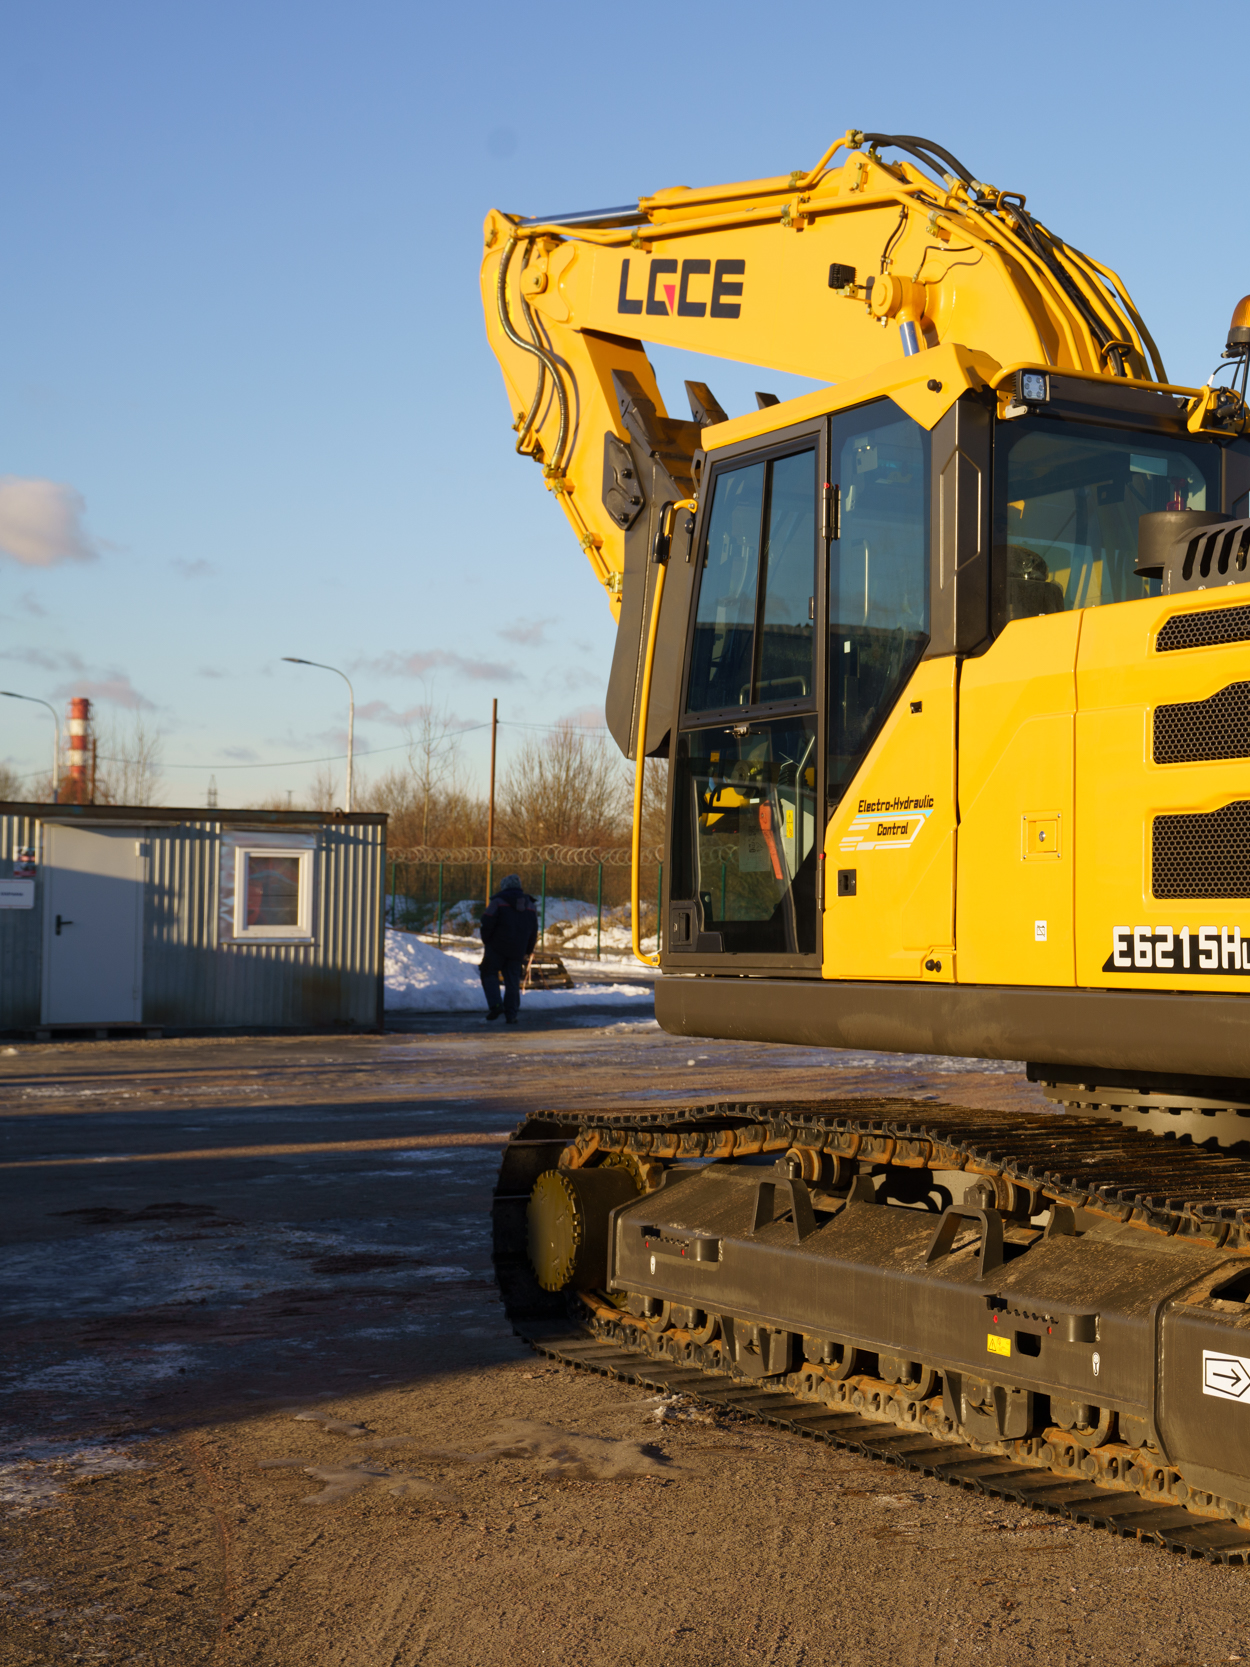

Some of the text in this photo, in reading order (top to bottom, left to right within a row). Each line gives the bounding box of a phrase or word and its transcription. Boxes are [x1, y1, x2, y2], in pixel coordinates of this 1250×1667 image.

[618, 258, 746, 319] LGCE
[858, 794, 934, 813] Electro-Hydraulic
[877, 822, 909, 836] Control
